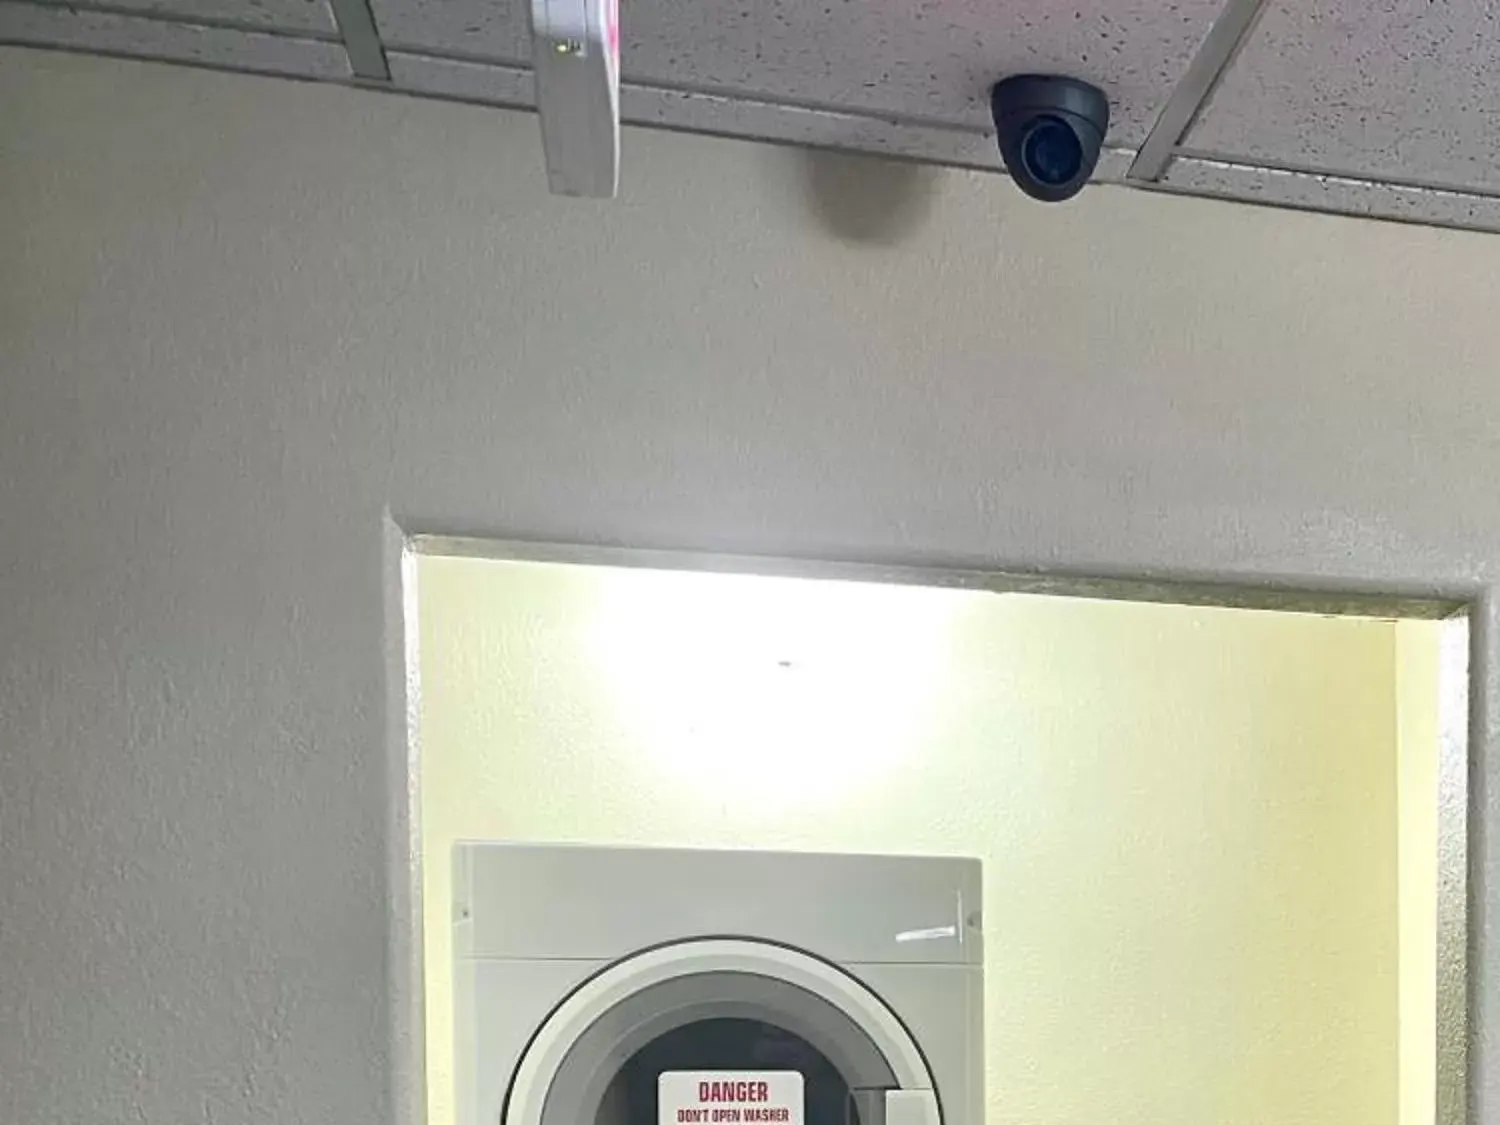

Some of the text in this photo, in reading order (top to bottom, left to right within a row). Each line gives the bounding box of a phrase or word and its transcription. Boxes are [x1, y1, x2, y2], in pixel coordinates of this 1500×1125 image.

[698, 1081, 769, 1103] DANGER
[677, 1108, 789, 1123] DON'T OPEN WASHER
